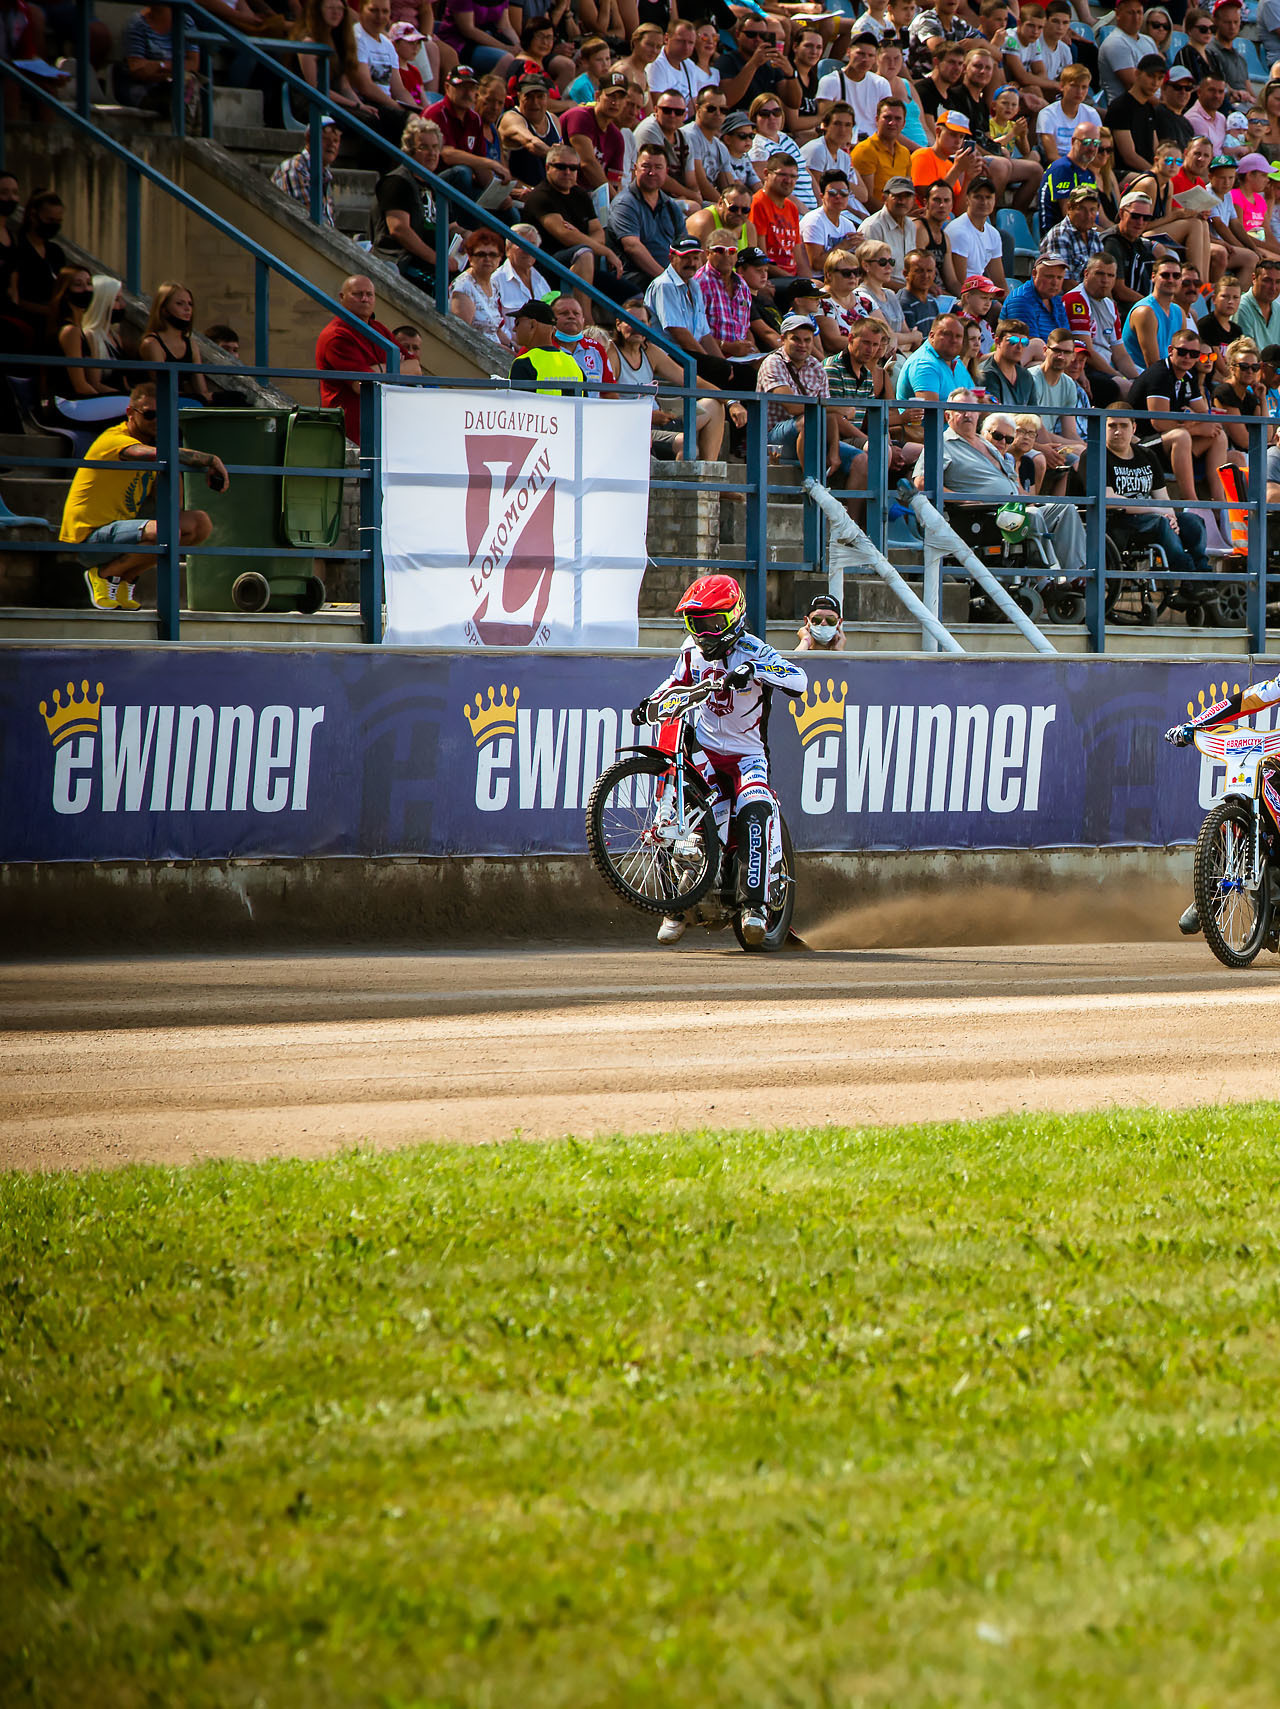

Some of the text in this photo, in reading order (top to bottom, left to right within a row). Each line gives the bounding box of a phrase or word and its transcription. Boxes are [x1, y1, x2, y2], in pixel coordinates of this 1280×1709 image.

[464, 410, 559, 435] DAUGAVPILS
[469, 447, 552, 596] LOKOMOTIV
[764, 665, 791, 674] REAL
[663, 696, 682, 711] REAL
[1226, 738, 1263, 748] ABRAMCZYK
[52, 704, 325, 814] ewinner
[801, 704, 1057, 815] ewinner
